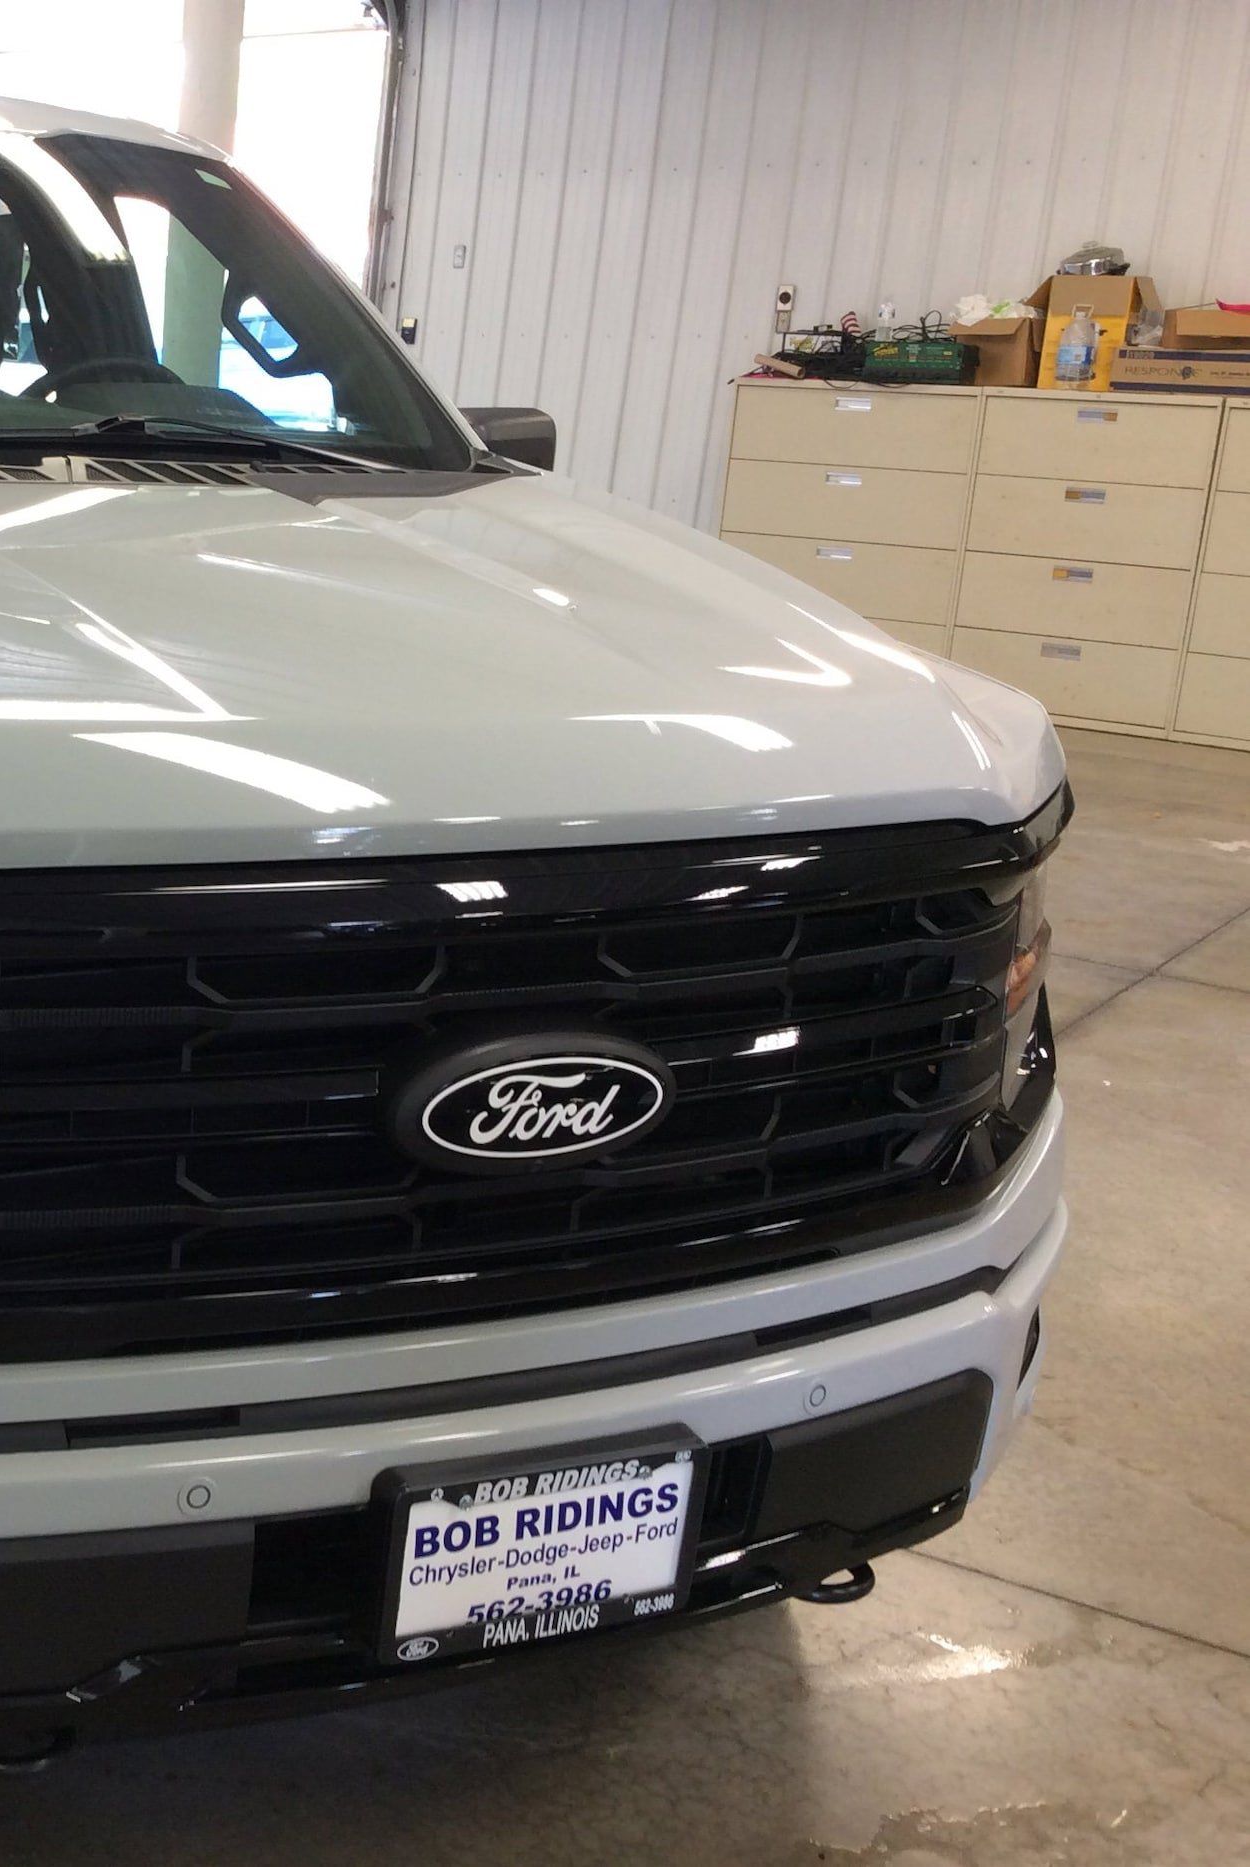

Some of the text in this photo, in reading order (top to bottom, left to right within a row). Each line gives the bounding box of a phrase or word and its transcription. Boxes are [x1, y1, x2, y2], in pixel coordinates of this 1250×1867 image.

[1125, 365, 1203, 377] RESPONE
[469, 1073, 620, 1144] Ford
[474, 1459, 640, 1504] BOB RIDINGS
[414, 1483, 679, 1559] BOB RIDINGS
[507, 1565, 580, 1591] Pana, IL
[467, 1579, 612, 1624] 562-3986
[534, 1604, 600, 1639] ILLINOIS
